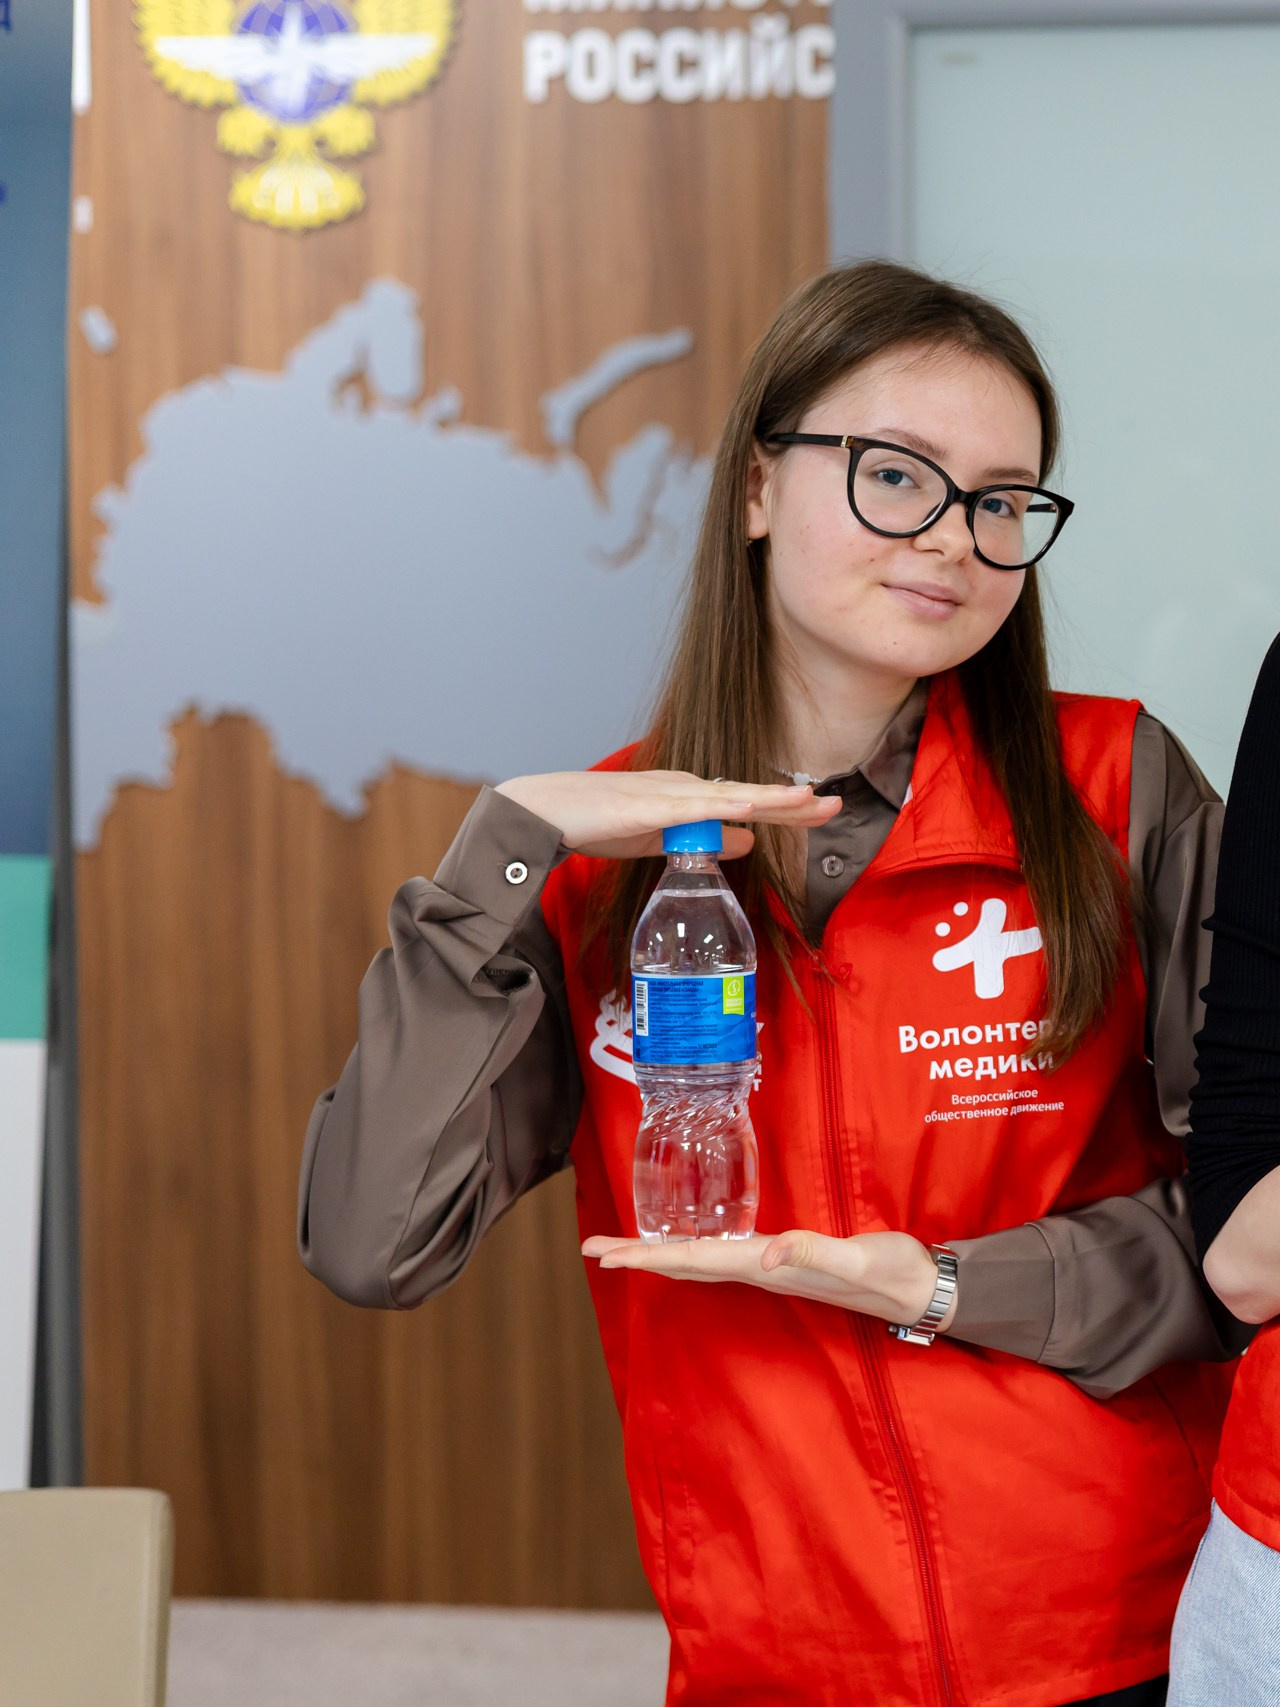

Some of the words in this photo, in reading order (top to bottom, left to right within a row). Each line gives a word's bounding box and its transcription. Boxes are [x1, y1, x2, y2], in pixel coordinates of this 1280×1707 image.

[523, 12, 836, 104] РОССИЙС
[898, 1019, 1062, 1053] Волонтер
[929, 1051, 1054, 1081] медики
[924, 1106, 1009, 1123] общественное
[1010, 1101, 1065, 1116] движение
[951, 1089, 1039, 1105] Всероссийское
